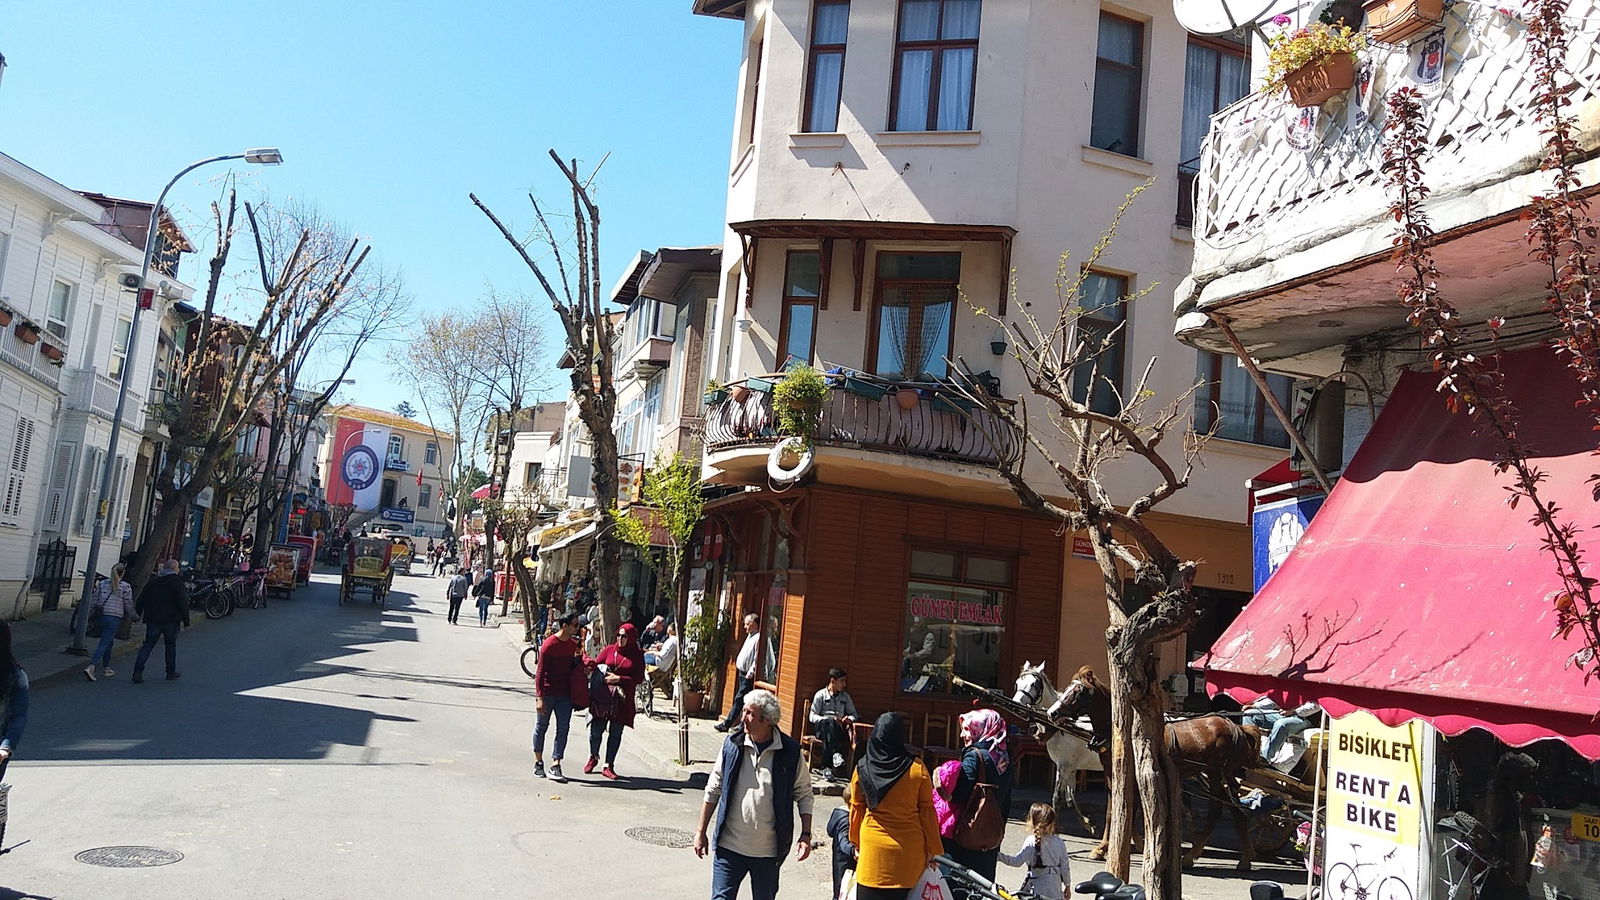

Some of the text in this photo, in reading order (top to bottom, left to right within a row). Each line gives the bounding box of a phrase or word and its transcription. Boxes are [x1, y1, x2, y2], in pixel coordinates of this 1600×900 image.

[911, 593, 1004, 625] GÜNEY EMLAK
[1338, 729, 1413, 763] BİSİKLET
[1336, 771, 1411, 805] RENT A
[1347, 801, 1396, 833] BİKE
